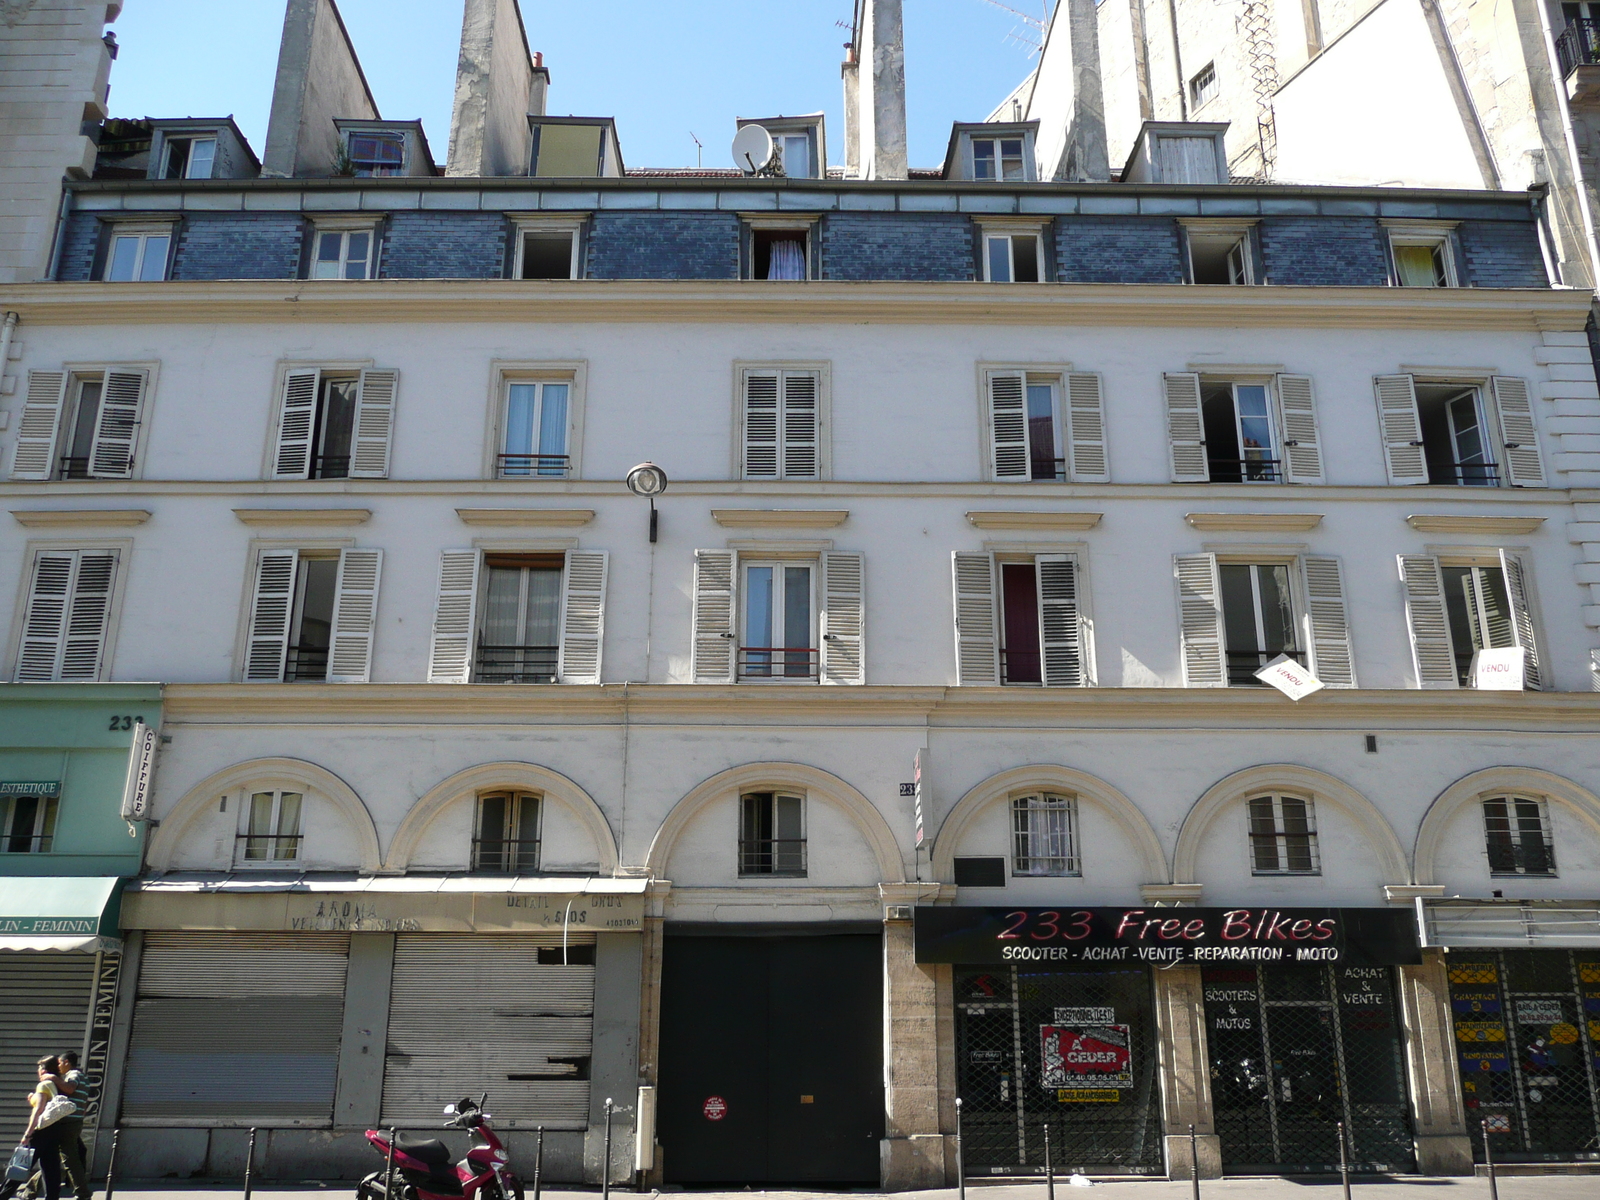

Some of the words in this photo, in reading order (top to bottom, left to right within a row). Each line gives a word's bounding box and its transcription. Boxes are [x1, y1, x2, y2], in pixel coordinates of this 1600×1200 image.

[1481, 663, 1510, 673] VENDU
[1276, 667, 1304, 687] VENDU
[135, 732, 154, 812] COIFFURE
[0, 782, 57, 795] ESTHETIQUE
[900, 784, 916, 796] 23
[31, 920, 95, 932] FEMININ
[996, 910, 1093, 941] 233
[1114, 910, 1205, 941] Free
[1002, 946, 1068, 961] SCOOTER
[1081, 946, 1130, 961] ACHAT
[1296, 946, 1339, 961] MOTO
[1344, 967, 1384, 979] ACHAT
[1361, 980, 1372, 992] &
[1205, 990, 1257, 1002] SCOOTERS
[1343, 993, 1384, 1005] VENTE
[1228, 1003, 1238, 1015] &
[1216, 1017, 1252, 1030] MOTOS
[1071, 1039, 1083, 1051] A
[1067, 1051, 1117, 1063] CEDER
